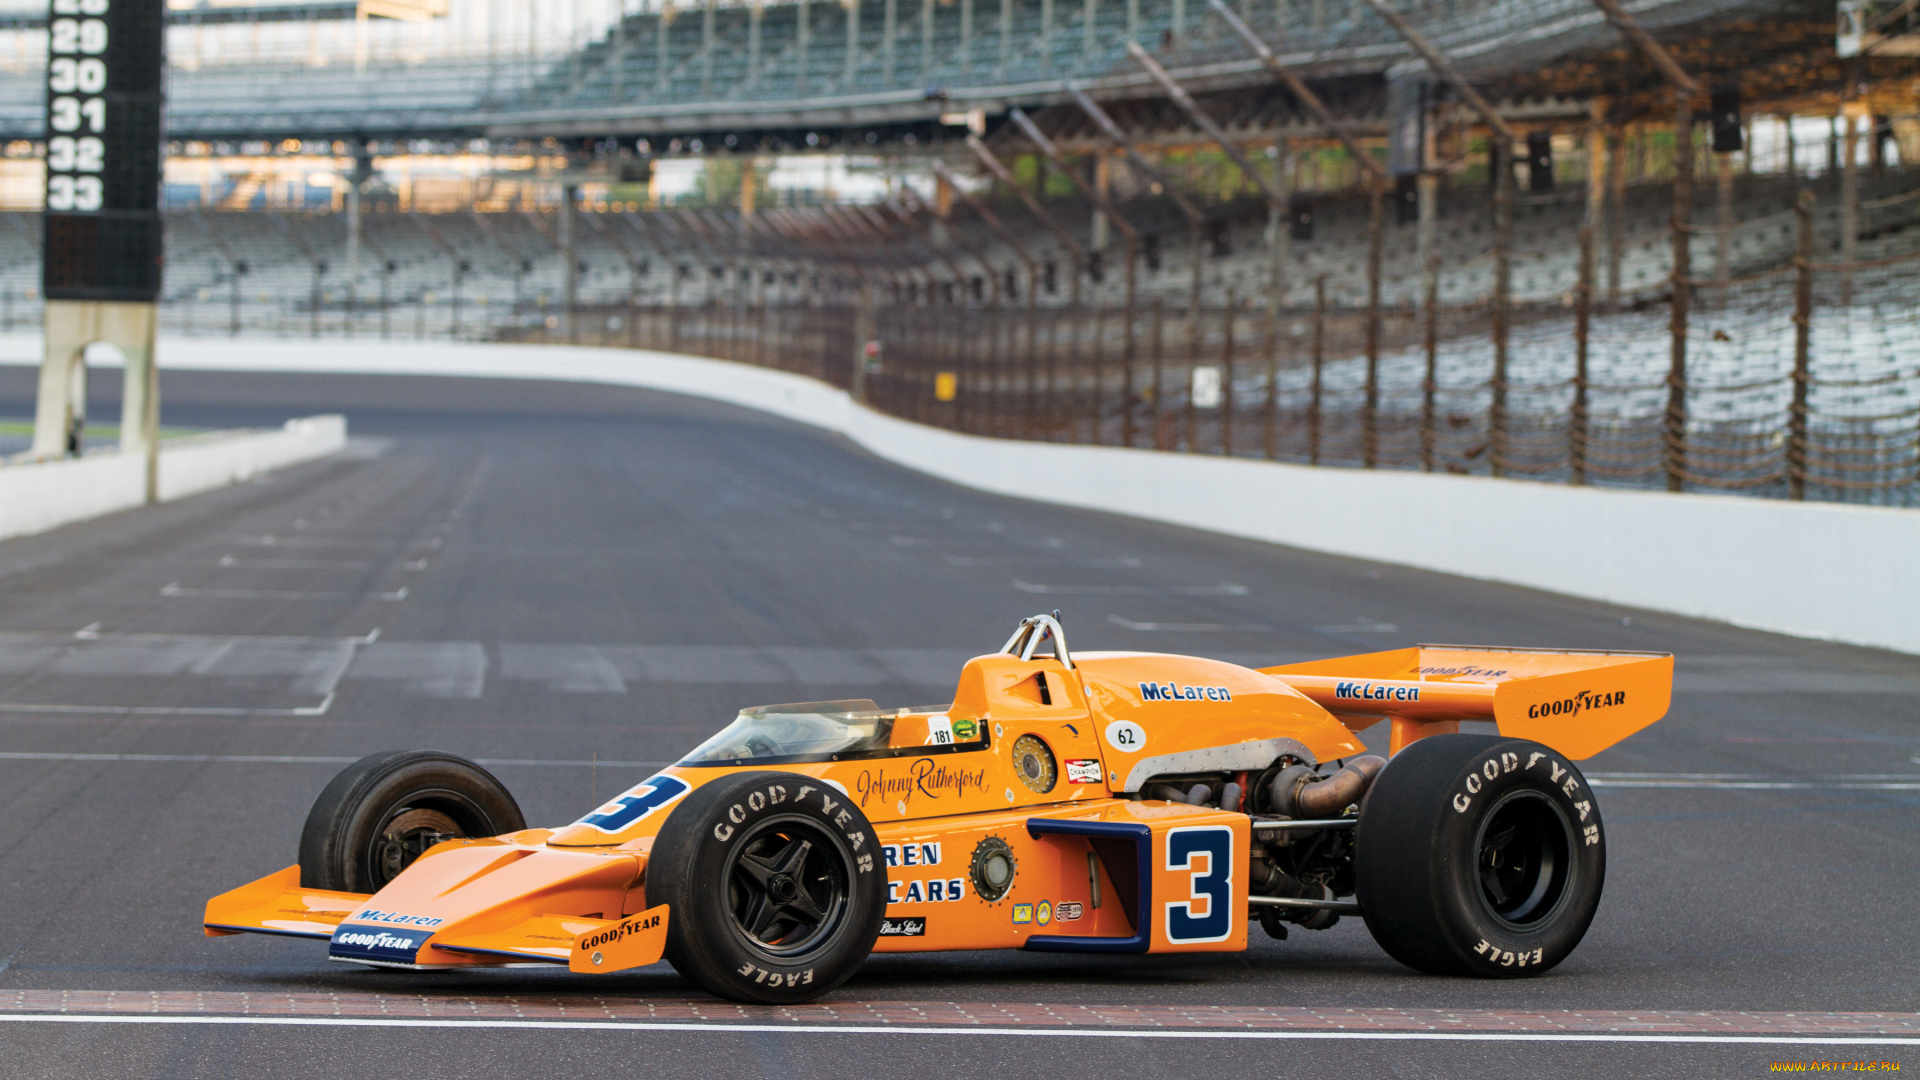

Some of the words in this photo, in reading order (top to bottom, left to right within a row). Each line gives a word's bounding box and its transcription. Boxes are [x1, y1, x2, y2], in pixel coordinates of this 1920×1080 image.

[51, 18, 108, 54] 29
[49, 57, 107, 93] 30
[51, 96, 106, 132] 31
[48, 136, 105, 172] 32
[48, 175, 103, 211] 33
[1138, 681, 1232, 701] McLaren
[1335, 681, 1419, 702] McLaren
[934, 730, 951, 743] 181
[1118, 729, 1135, 744] 62
[857, 769, 915, 807] Johnny
[910, 758, 990, 799] Rutherford
[1070, 768, 1100, 776] CHAMPION
[573, 774, 692, 834] 3
[1165, 825, 1233, 945] 3
[353, 909, 444, 927] McLaren
[880, 920, 902, 934] Black
[902, 920, 924, 935] Label
[1473, 938, 1544, 968] EAGLE
[737, 960, 815, 988] EAGLE
